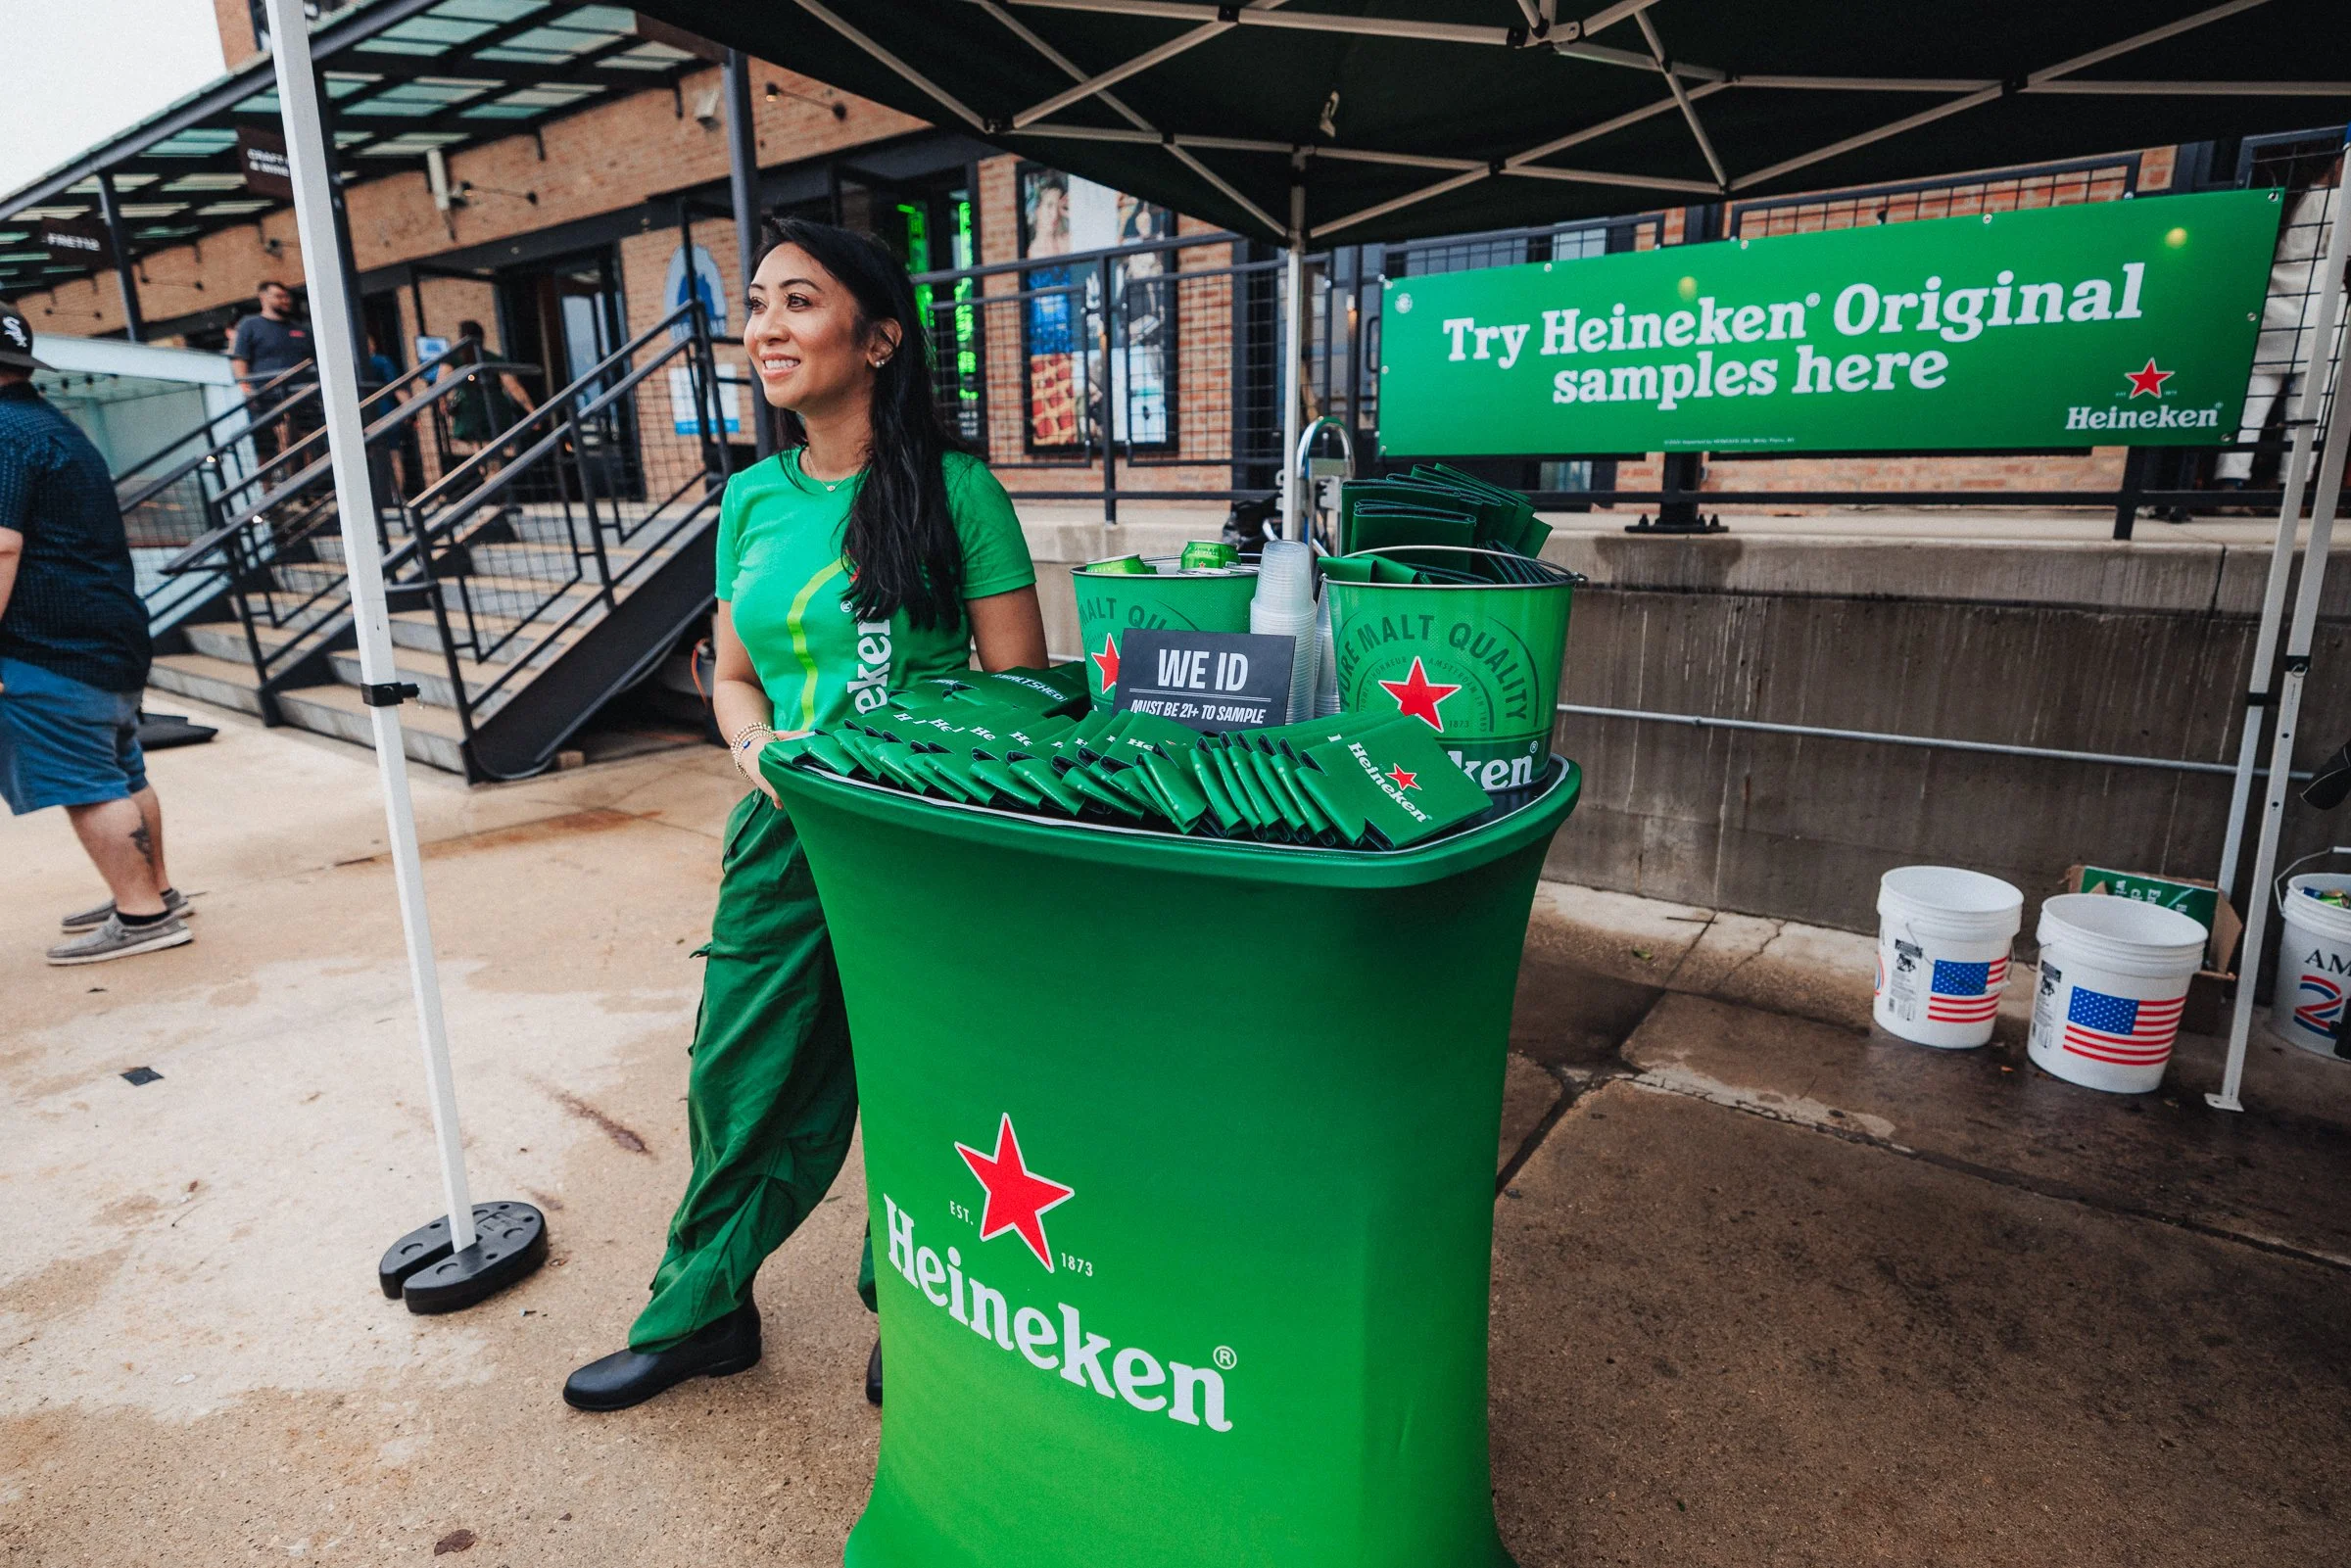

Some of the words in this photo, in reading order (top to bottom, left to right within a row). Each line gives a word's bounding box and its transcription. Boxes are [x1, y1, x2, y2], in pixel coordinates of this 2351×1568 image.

[1443, 317, 1530, 369] Try
[1833, 262, 2145, 343] Original
[1553, 351, 1779, 410] samples
[1792, 345, 1949, 394] here
[1157, 648, 1210, 689] WE
[1215, 652, 1249, 691] ID
[1339, 640, 1361, 708] PURE
[1357, 614, 1434, 654] MALT
[1449, 622, 1527, 721] QUALITY
[1130, 699, 1166, 716] MUST
[1164, 702, 1180, 717] BE
[1179, 703, 1199, 718] 21+
[1201, 704, 1217, 720] TO
[1217, 706, 1267, 725] SAMPLE
[1449, 719, 1470, 729] 1873
[949, 1200, 974, 1225] EST.
[1061, 1252, 1093, 1277] 1873
